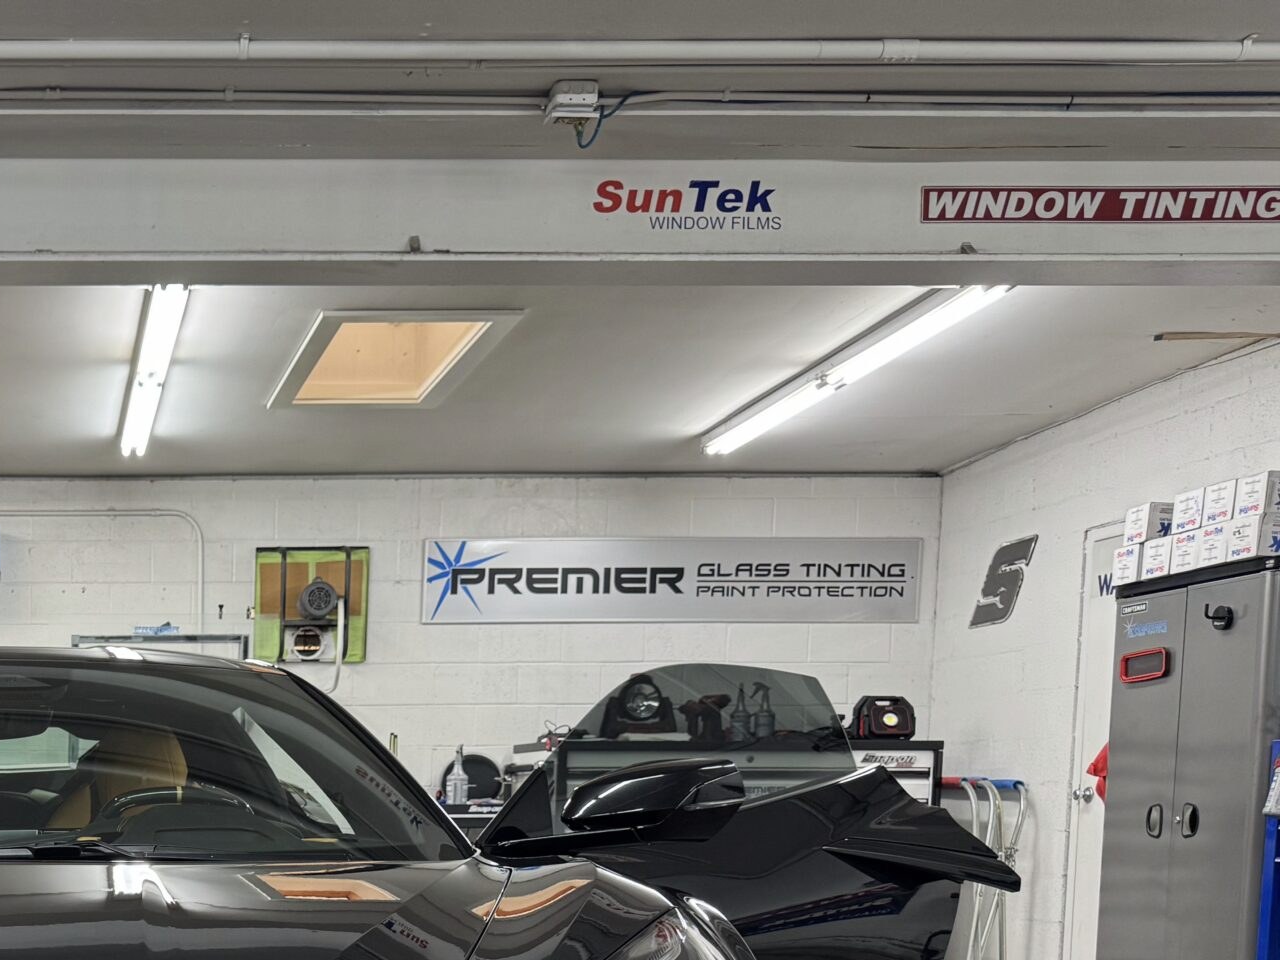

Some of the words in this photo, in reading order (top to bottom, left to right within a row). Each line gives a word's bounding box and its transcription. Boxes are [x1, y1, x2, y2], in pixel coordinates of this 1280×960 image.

[593, 180, 776, 213] SunTek
[928, 191, 1105, 219] WINDOW
[1119, 191, 1280, 219] TINTING
[650, 216, 726, 230] WINDOW
[731, 216, 782, 230] FILMS
[450, 567, 686, 595] PREMIER
[697, 563, 791, 578] GLASS
[799, 563, 907, 578] TINTING
[696, 586, 760, 597] PAINT
[766, 586, 905, 598] PROTECTION
